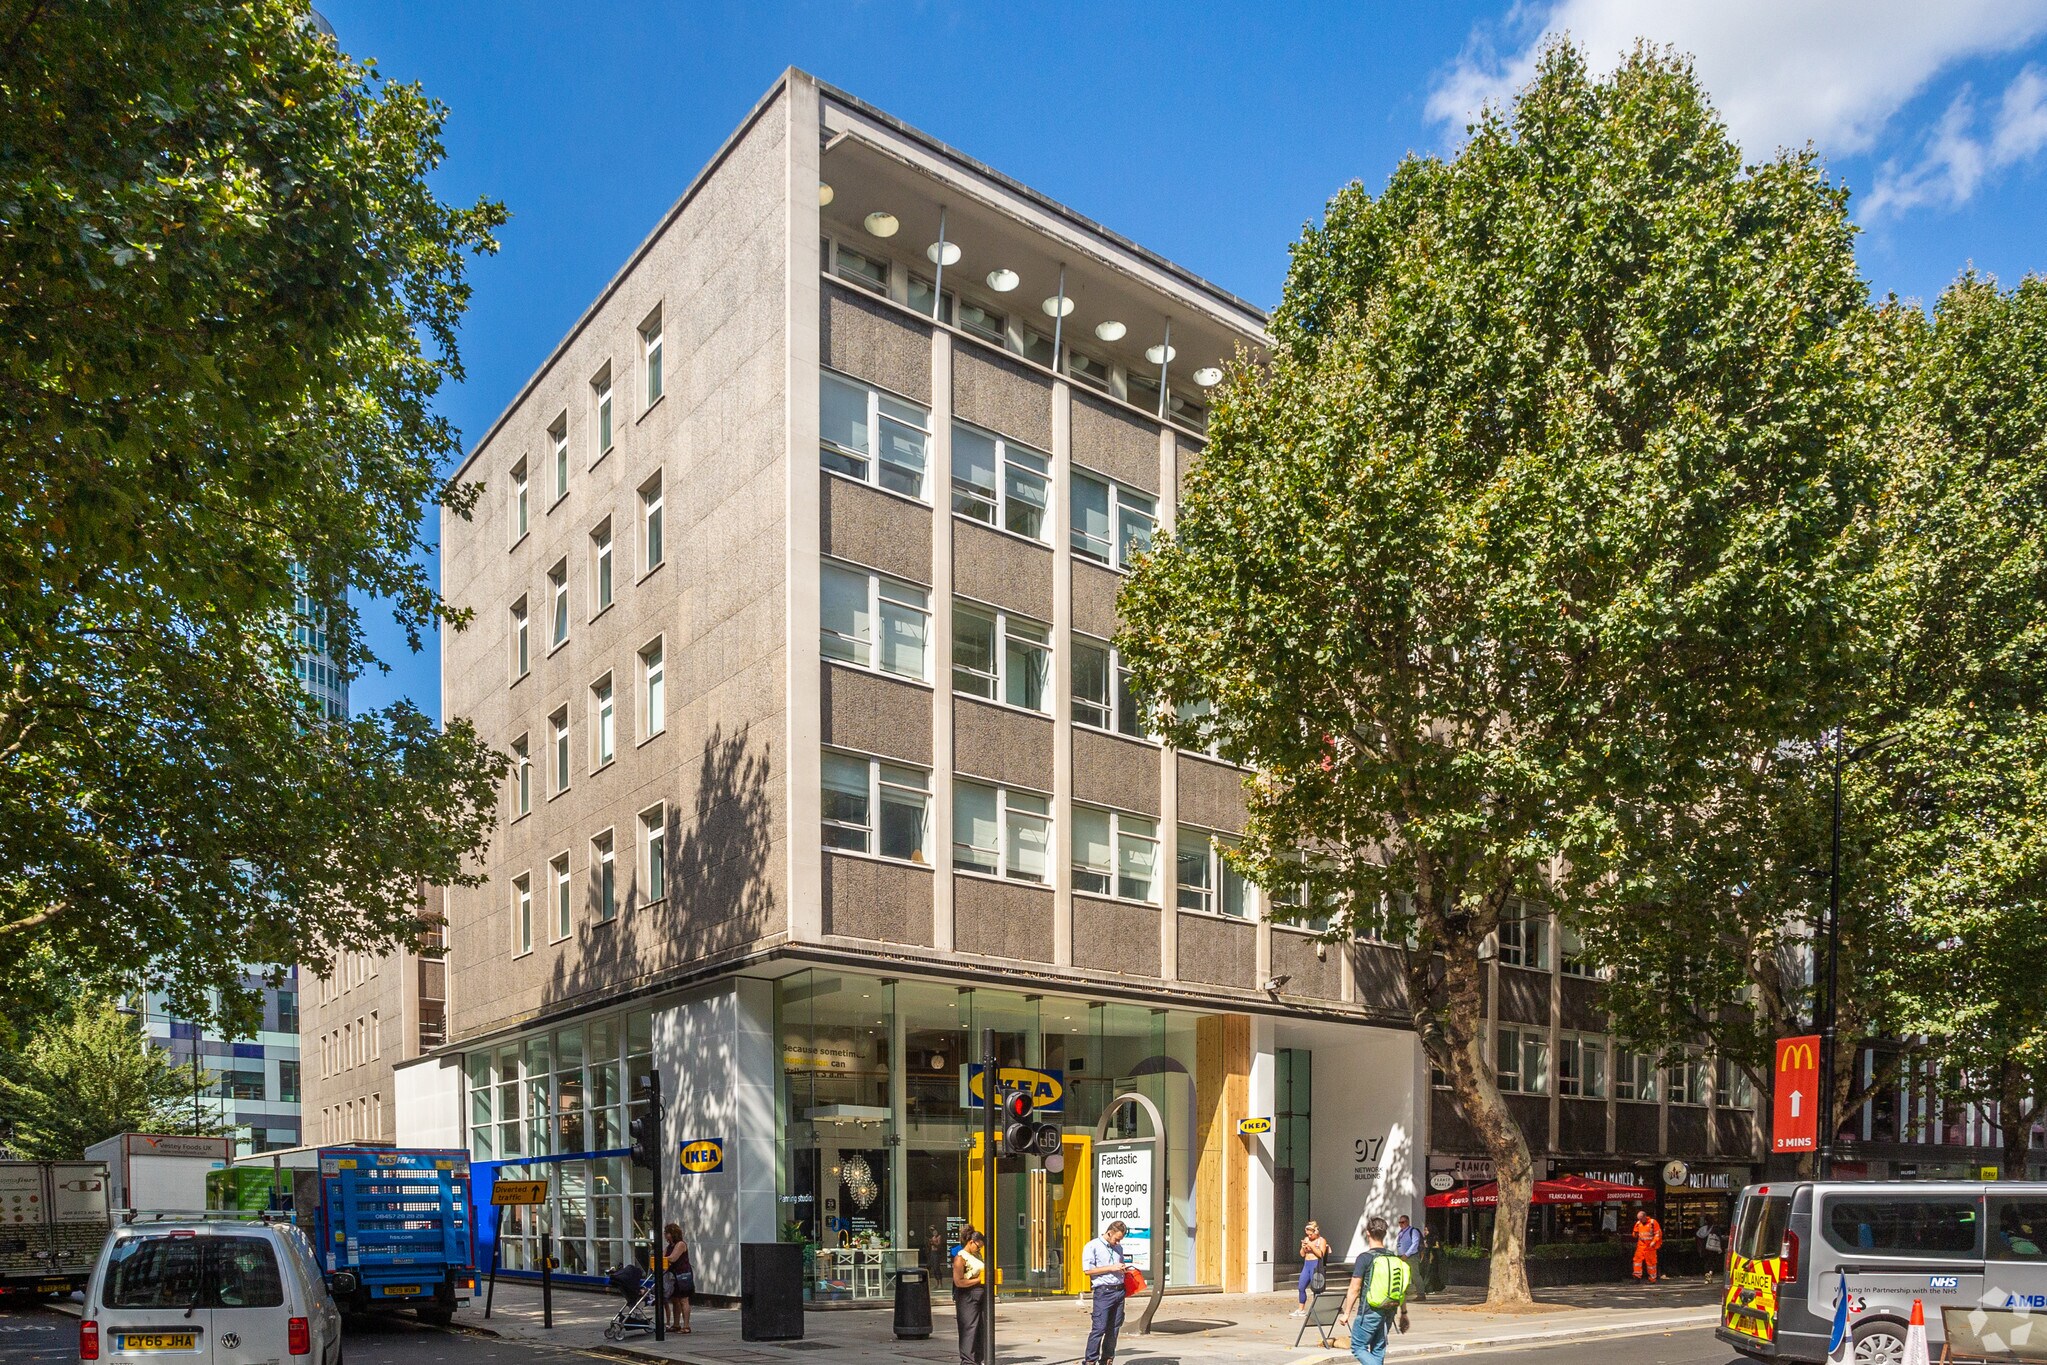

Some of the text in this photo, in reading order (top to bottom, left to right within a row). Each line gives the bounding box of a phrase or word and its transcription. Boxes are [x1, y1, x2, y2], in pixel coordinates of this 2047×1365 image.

[783, 1043, 818, 1054] Because
[831, 1060, 846, 1068] can
[983, 1078, 1054, 1098] KEA
[159, 1143, 182, 1151] Vestey
[182, 1143, 202, 1151] Foods
[1777, 1137, 1812, 1147] 3 MINS
[1354, 1136, 1384, 1162] 97
[378, 1155, 416, 1164] HSS Hire
[685, 1149, 719, 1163] IKEA
[1101, 1153, 1138, 1165] Fantastic
[1354, 1166, 1383, 1174] NETWORK
[1455, 1161, 1490, 1172] FRANCO
[1101, 1169, 1124, 1179] news.
[1354, 1173, 1381, 1181] BUILDING
[1690, 1173, 1704, 1188] PRET
[1704, 1174, 1709, 1188] A
[1101, 1181, 1148, 1195] We're going
[498, 1193, 521, 1201] traffic
[1101, 1195, 1133, 1208] to rip up
[1450, 1196, 1485, 1205] SOURDUGH
[1101, 1208, 1141, 1221] your road.
[1735, 1270, 1769, 1289] AMBULANCE
[1930, 1277, 1957, 1287] NHS
[1834, 1286, 1862, 1294] Wking
[1872, 1286, 1911, 1294] Partnership
[2005, 1294, 2047, 1308] AMB
[127, 1335, 192, 1347] CY66 JHA
